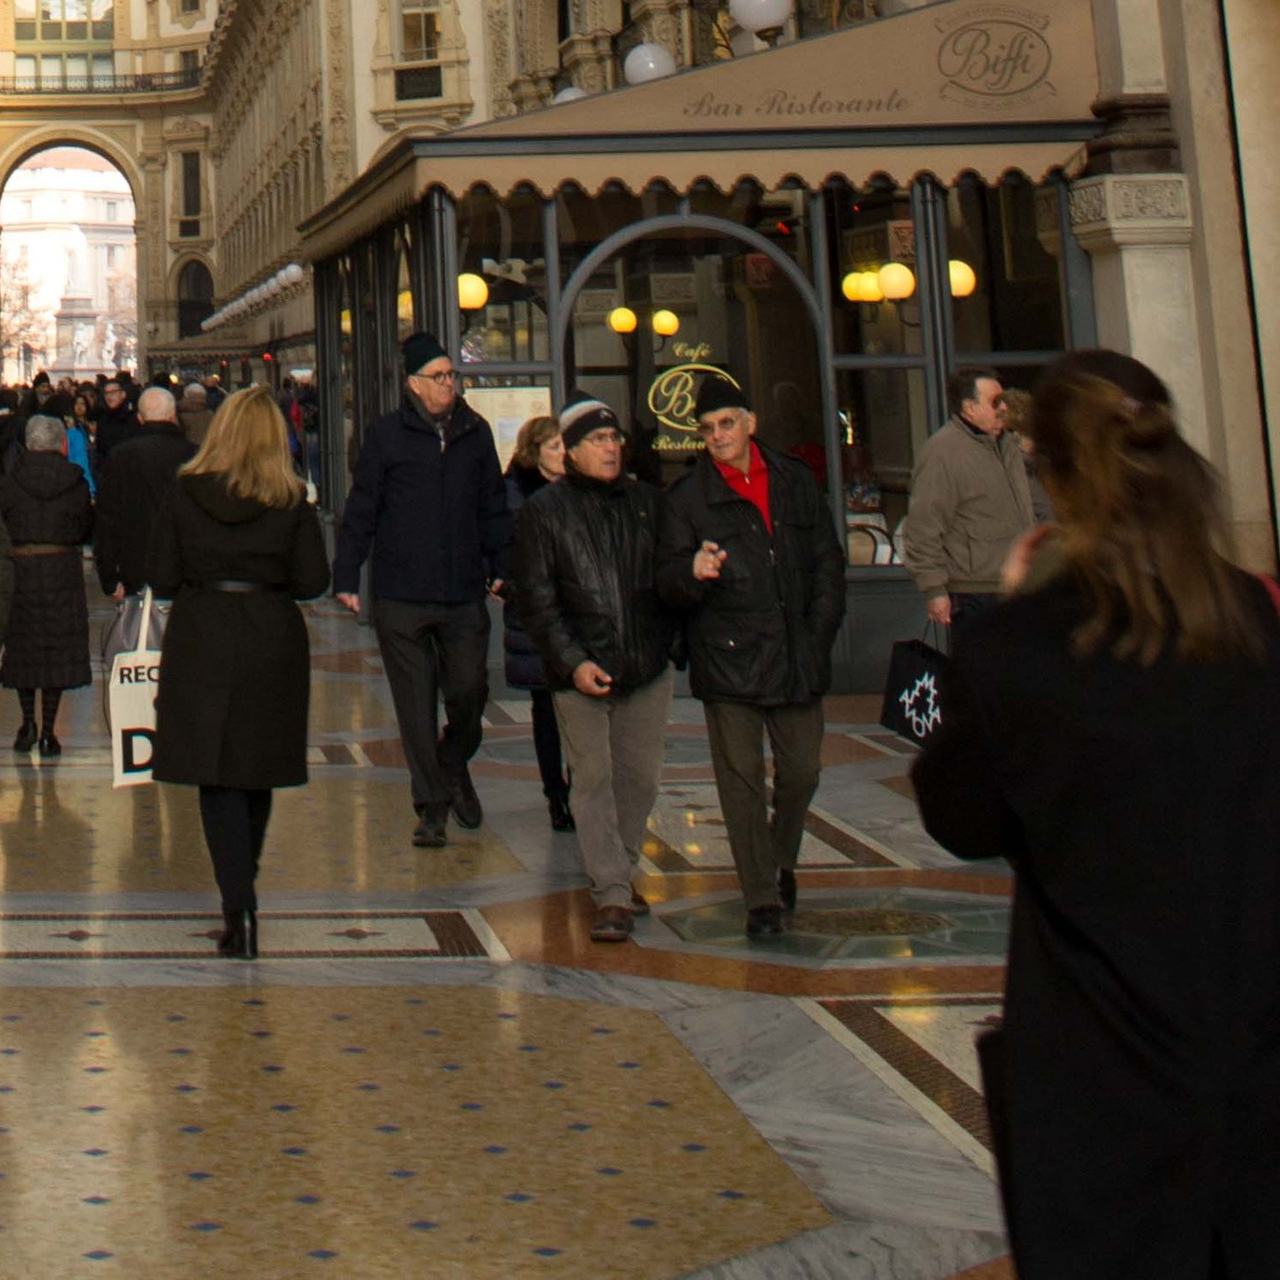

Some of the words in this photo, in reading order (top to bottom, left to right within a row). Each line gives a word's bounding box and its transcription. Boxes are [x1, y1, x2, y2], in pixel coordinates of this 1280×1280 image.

[948, 27, 1035, 90] Biffi
[682, 92, 744, 118] Bar
[755, 87, 909, 116] Ristorante
[672, 341, 712, 363] Café
